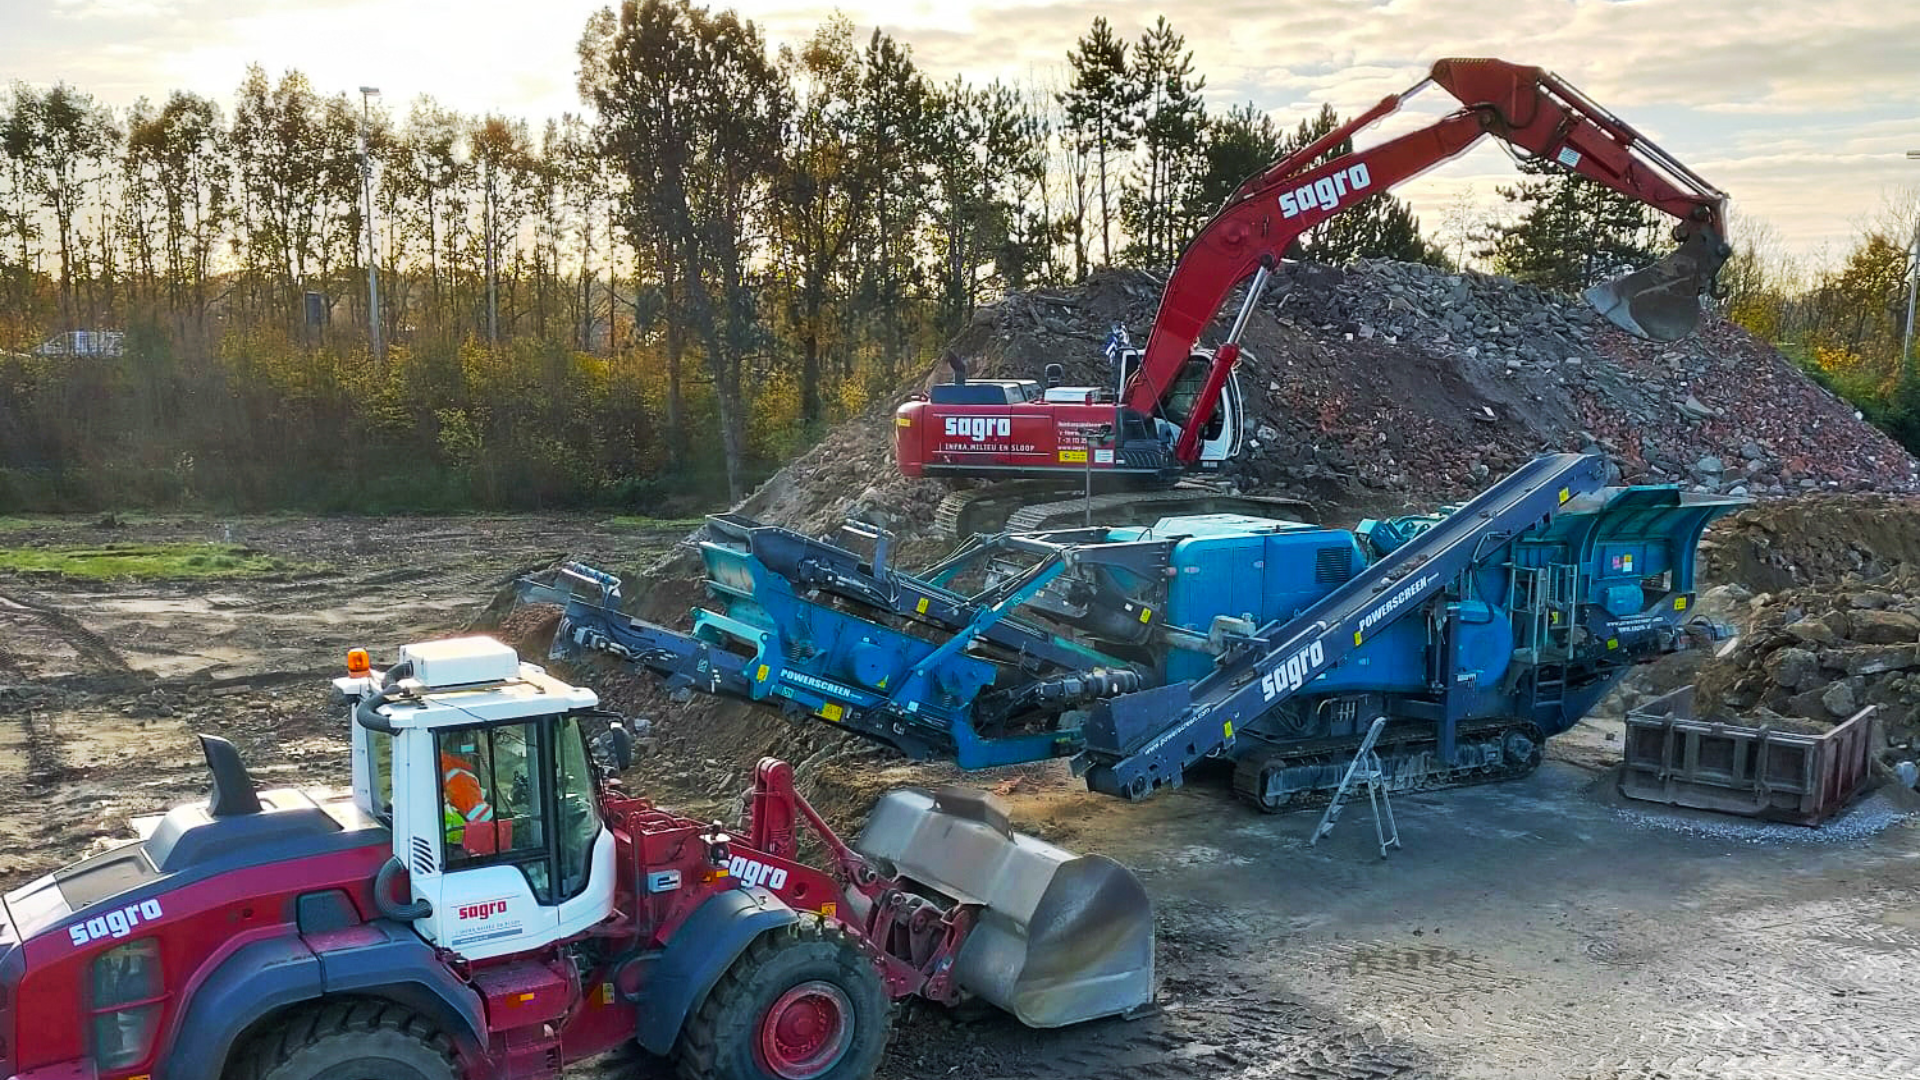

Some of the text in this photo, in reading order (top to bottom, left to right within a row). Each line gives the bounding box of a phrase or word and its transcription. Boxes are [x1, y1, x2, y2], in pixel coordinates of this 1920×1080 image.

[1278, 163, 1371, 219] sagro
[945, 418, 1011, 441] sagro
[999, 443, 1009, 451] EN
[1010, 444, 1035, 452] SLOOP
[1358, 576, 1427, 632] POWERSCREEN
[780, 668, 851, 697] POWERSCREEN
[1261, 639, 1325, 702] sagro
[69, 899, 163, 946] sagro
[459, 900, 507, 919] sagro
